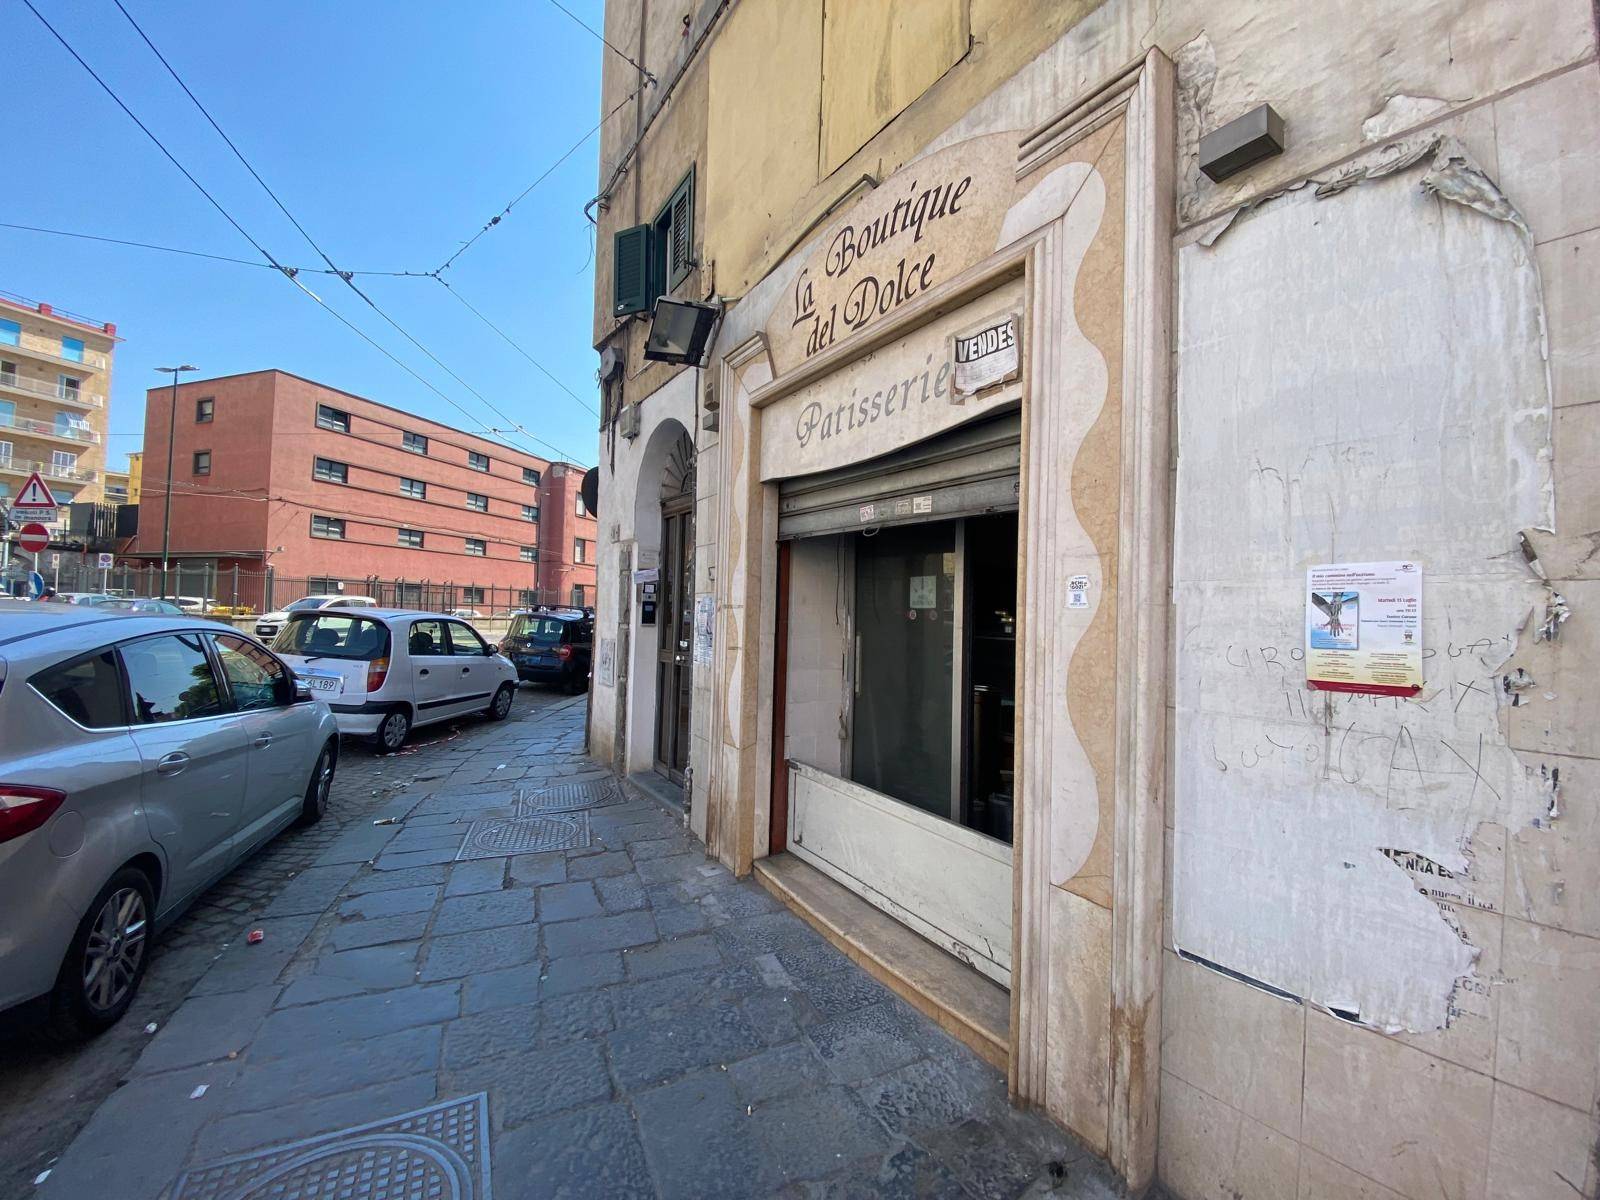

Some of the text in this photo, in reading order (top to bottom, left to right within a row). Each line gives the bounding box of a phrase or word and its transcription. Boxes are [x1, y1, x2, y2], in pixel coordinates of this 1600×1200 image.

[792, 175, 972, 329] La Boutique
[806, 252, 936, 357] del Dolce
[795, 352, 950, 449] Patisserie
